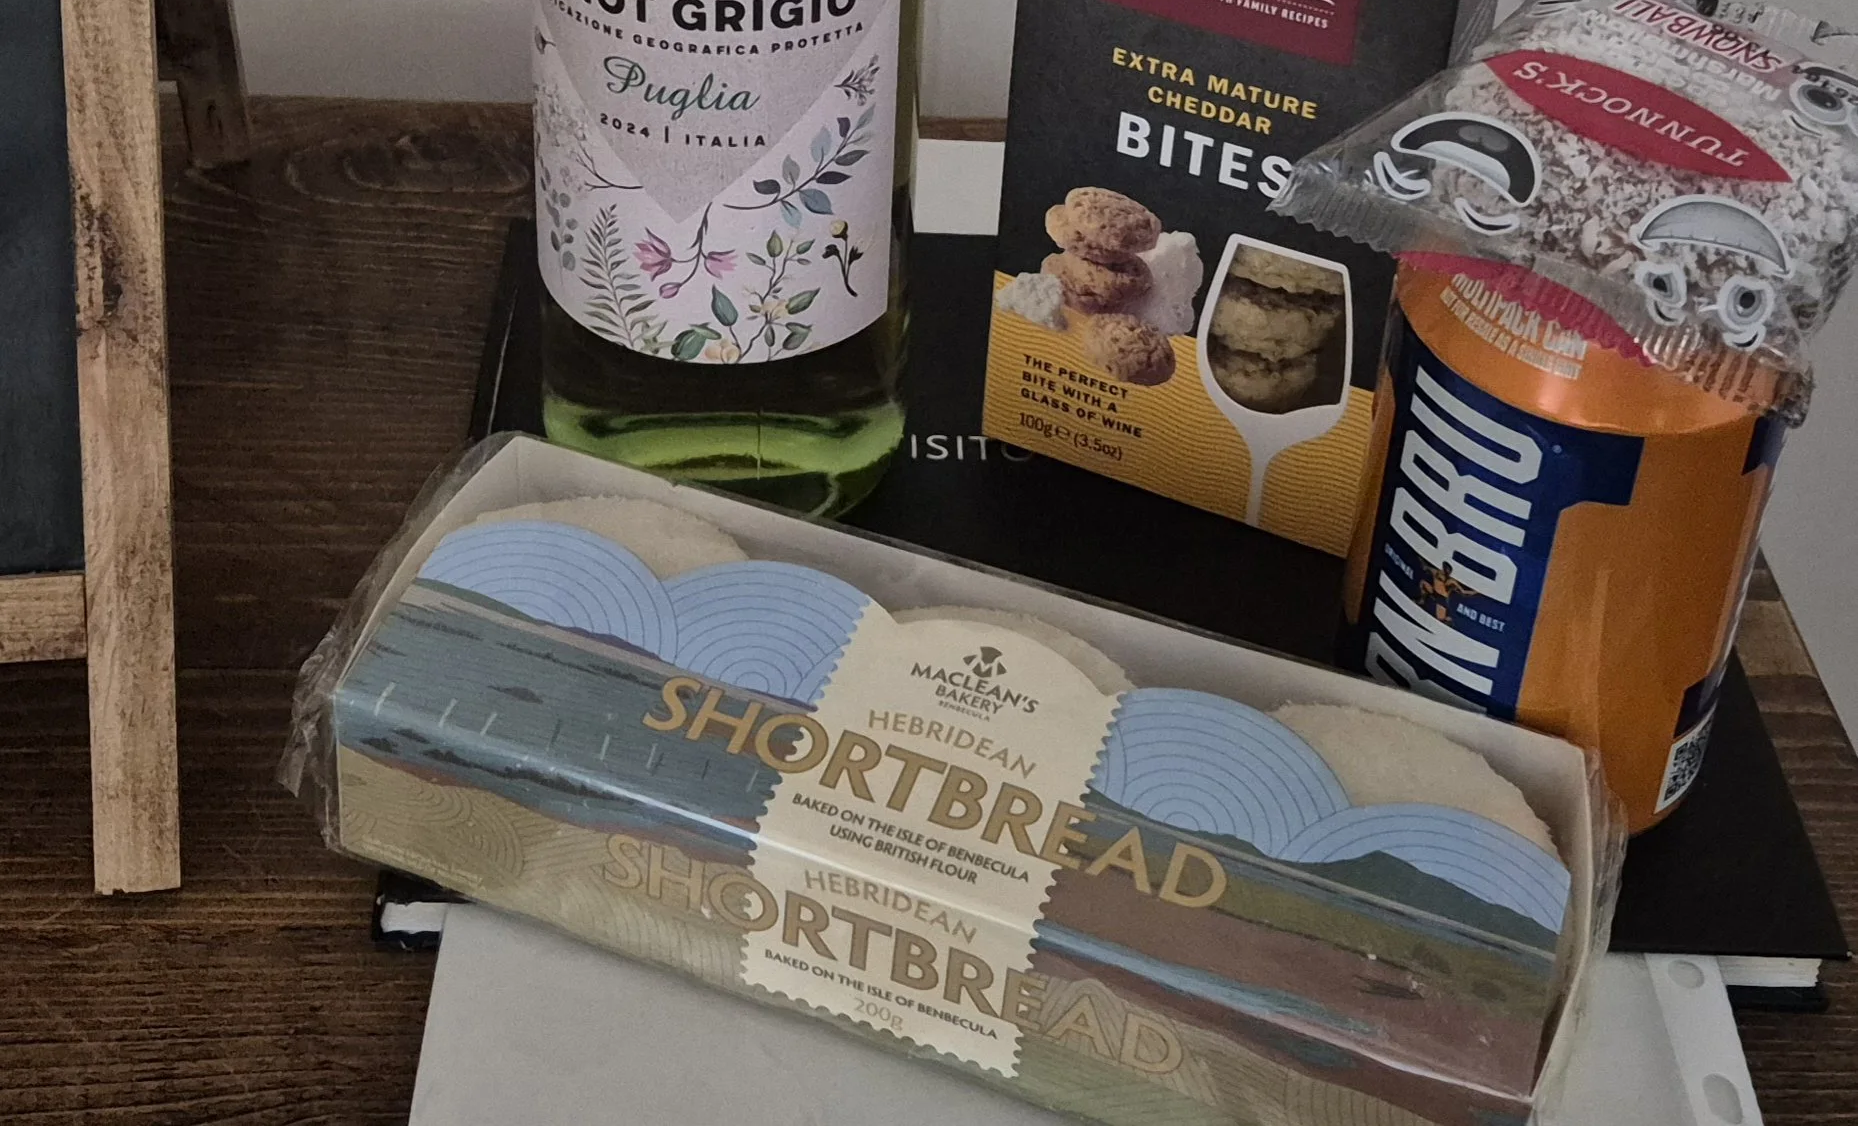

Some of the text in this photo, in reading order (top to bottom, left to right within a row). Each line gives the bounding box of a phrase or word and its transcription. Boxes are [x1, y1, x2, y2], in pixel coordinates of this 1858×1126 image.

[633, 33, 760, 55] GEOGRAFICA
[771, 21, 864, 54] PROTETTA
[1281, 8, 1329, 30] RECIPES
[603, 55, 761, 120] Puglia
[1111, 47, 1318, 120] EXTRA MATURE
[600, 113, 766, 147] 2024 ITALIA
[1147, 86, 1272, 135] CHEDDAR
[1513, 61, 1750, 167] TUNNOCK'S
[1116, 111, 1292, 199] BITES
[1022, 370, 1118, 413] BITE WITH A
[1023, 354, 1128, 399] THE PERFECT
[1020, 387, 1143, 438] GLASS OF WINE
[910, 433, 1034, 462] ISIT
[1073, 432, 1123, 461] (3.5oz)
[1456, 602, 1506, 632] AND BEST
[910, 662, 1039, 713] MACLEAN'S
[935, 684, 1004, 714] BAKERY
[938, 700, 990, 722] BENBECULA
[868, 709, 1037, 779] HEBRIDEAN
[642, 677, 1229, 908] SHORTBREAD
[792, 792, 1030, 883] BAKED ON THE ISLE OF BENBECULA
[829, 824, 978, 885] USING BRITISH FLOUR
[803, 868, 977, 944] HEBRIDEAN
[602, 835, 1184, 1075] SHORTBREAD
[764, 948, 998, 1040] BAKED ON THE ISLE OF BENBECULA
[852, 997, 904, 1032] 200g
